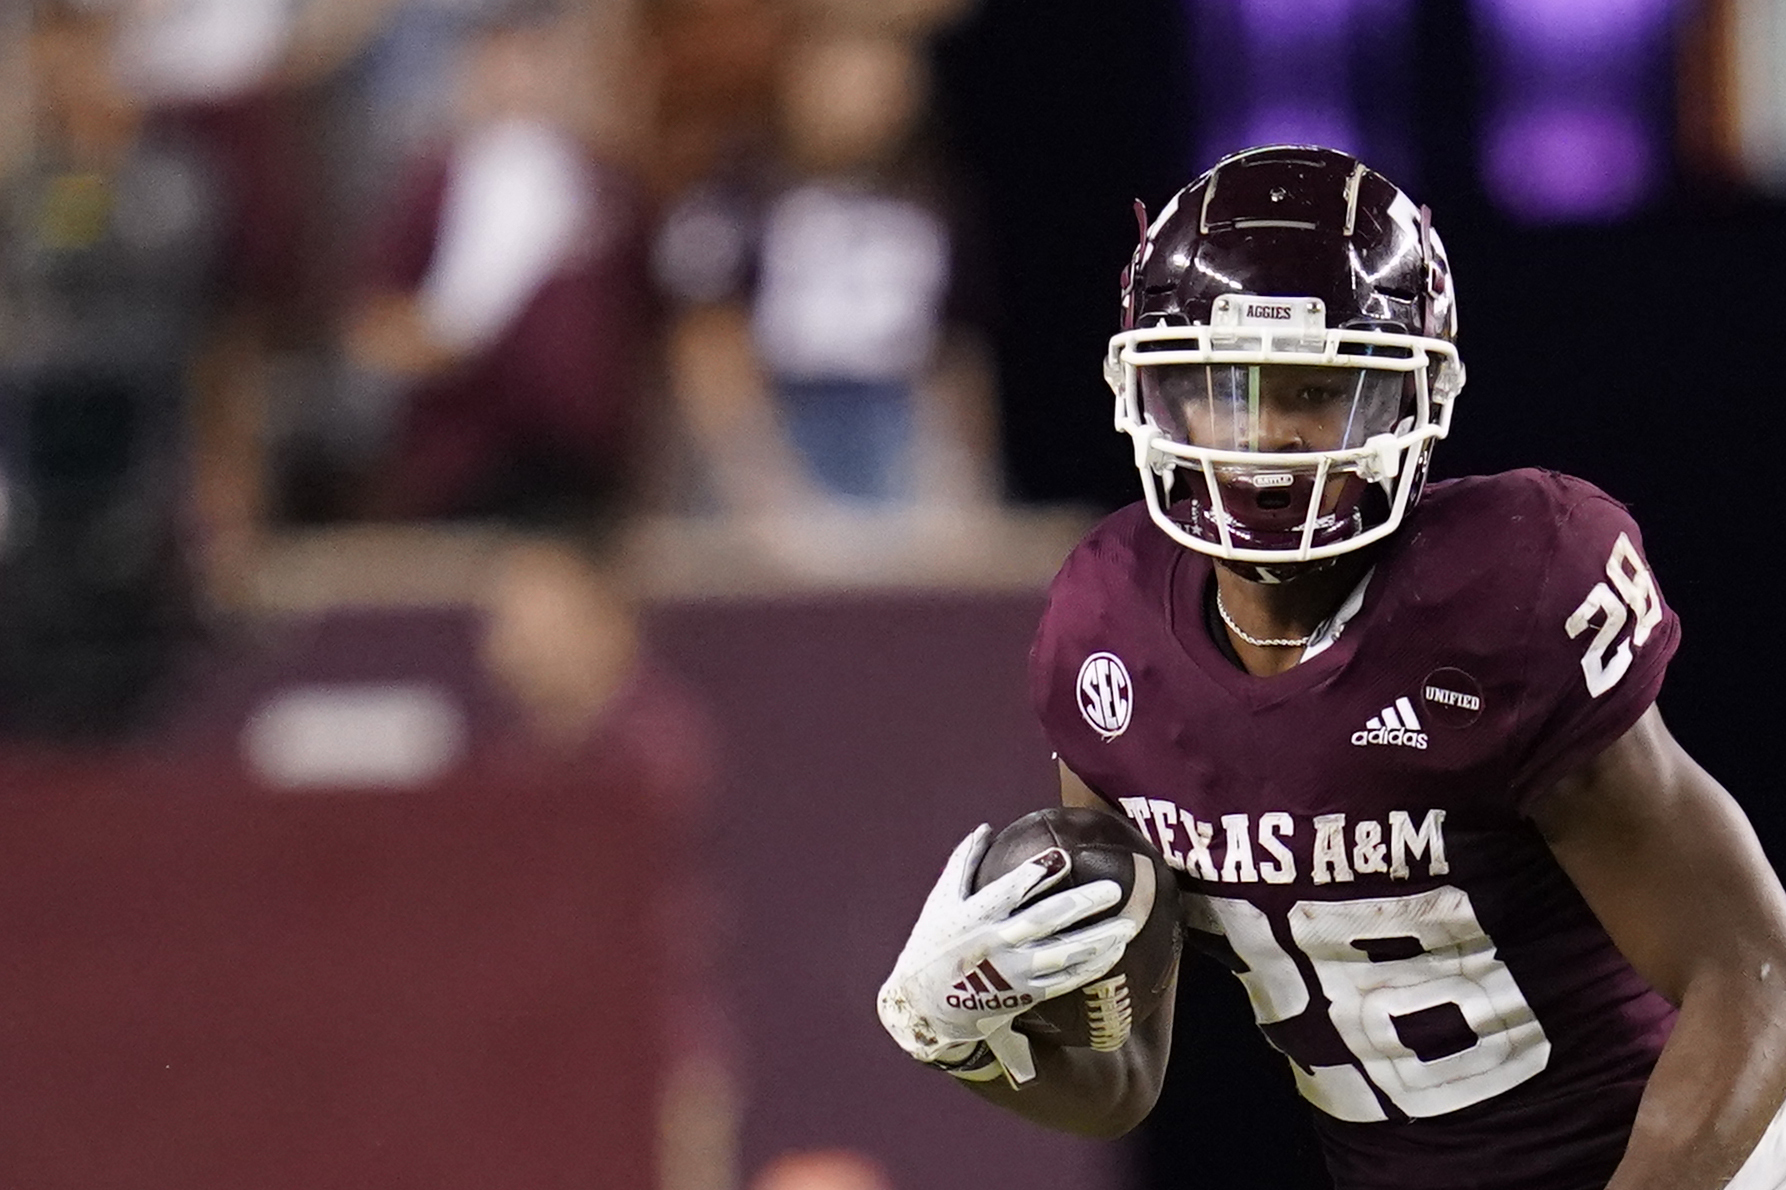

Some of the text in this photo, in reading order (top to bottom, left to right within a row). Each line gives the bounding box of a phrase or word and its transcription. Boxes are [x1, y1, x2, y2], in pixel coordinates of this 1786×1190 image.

[1246, 304, 1292, 320] AGGIES
[1564, 531, 1663, 698] 28
[1082, 658, 1128, 730] SEC
[1425, 685, 1480, 711] UNIFIED
[1351, 725, 1428, 750] adidas
[1118, 796, 1450, 886] TEXAS A&M
[945, 993, 1033, 1011] adidas
